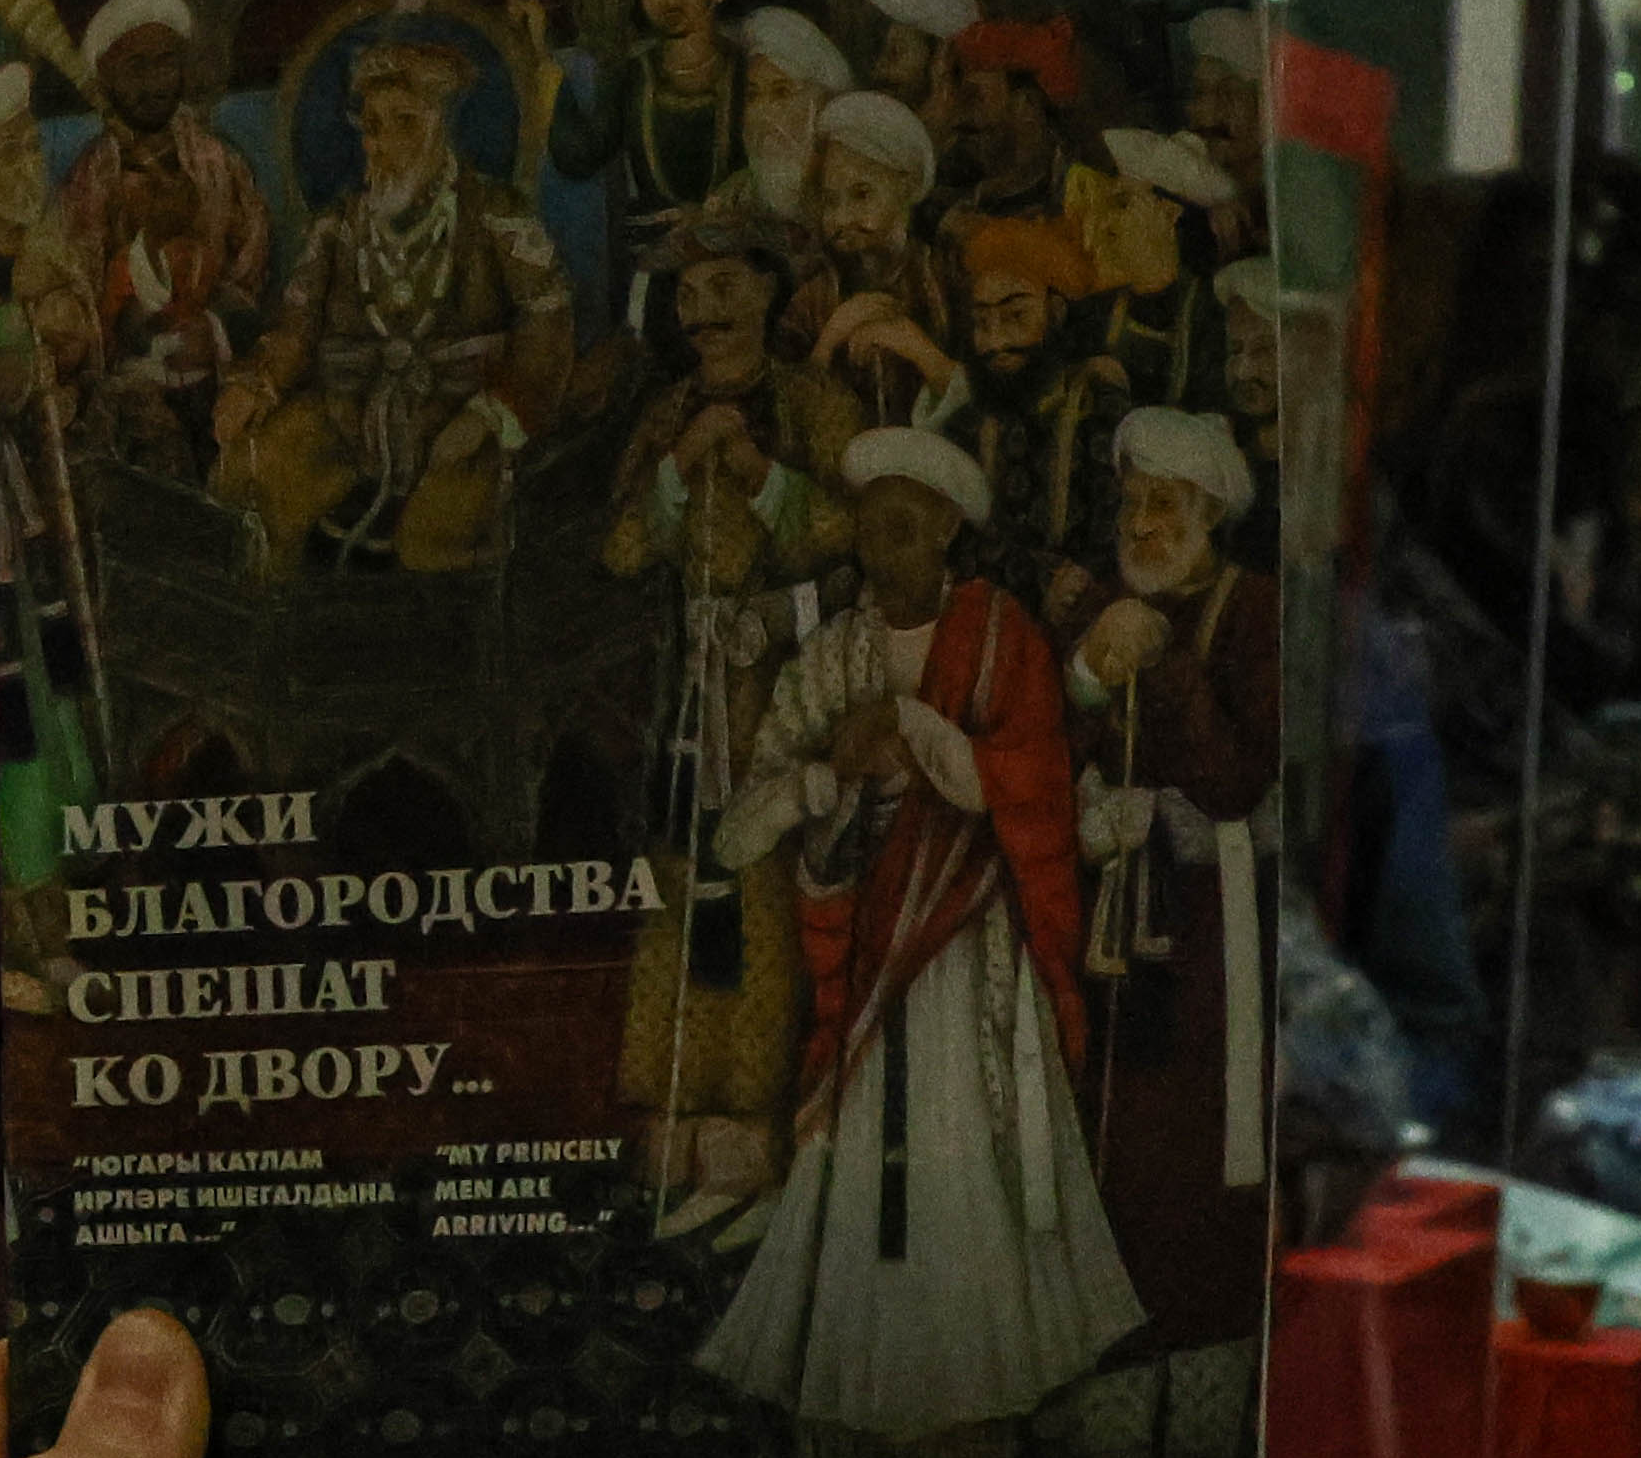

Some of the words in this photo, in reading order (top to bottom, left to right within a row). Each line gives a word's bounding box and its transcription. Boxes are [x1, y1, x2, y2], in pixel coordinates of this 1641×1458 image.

[63, 791, 318, 855] МУЖИ
[65, 856, 667, 941] БЛАГОРОДСТВА
[67, 958, 397, 1024] СПЕШАТ
[68, 1053, 183, 1109] КО
[197, 1042, 495, 1117] ДВОРУ...
[207, 1148, 325, 1173] КАТЛАМ
[494, 1137, 623, 1164] PRINCELY
[196, 1182, 396, 1209] ИШЕГАЛДЫНА
[433, 1177, 495, 1202] MEN
[500, 1175, 554, 1199] ARE
